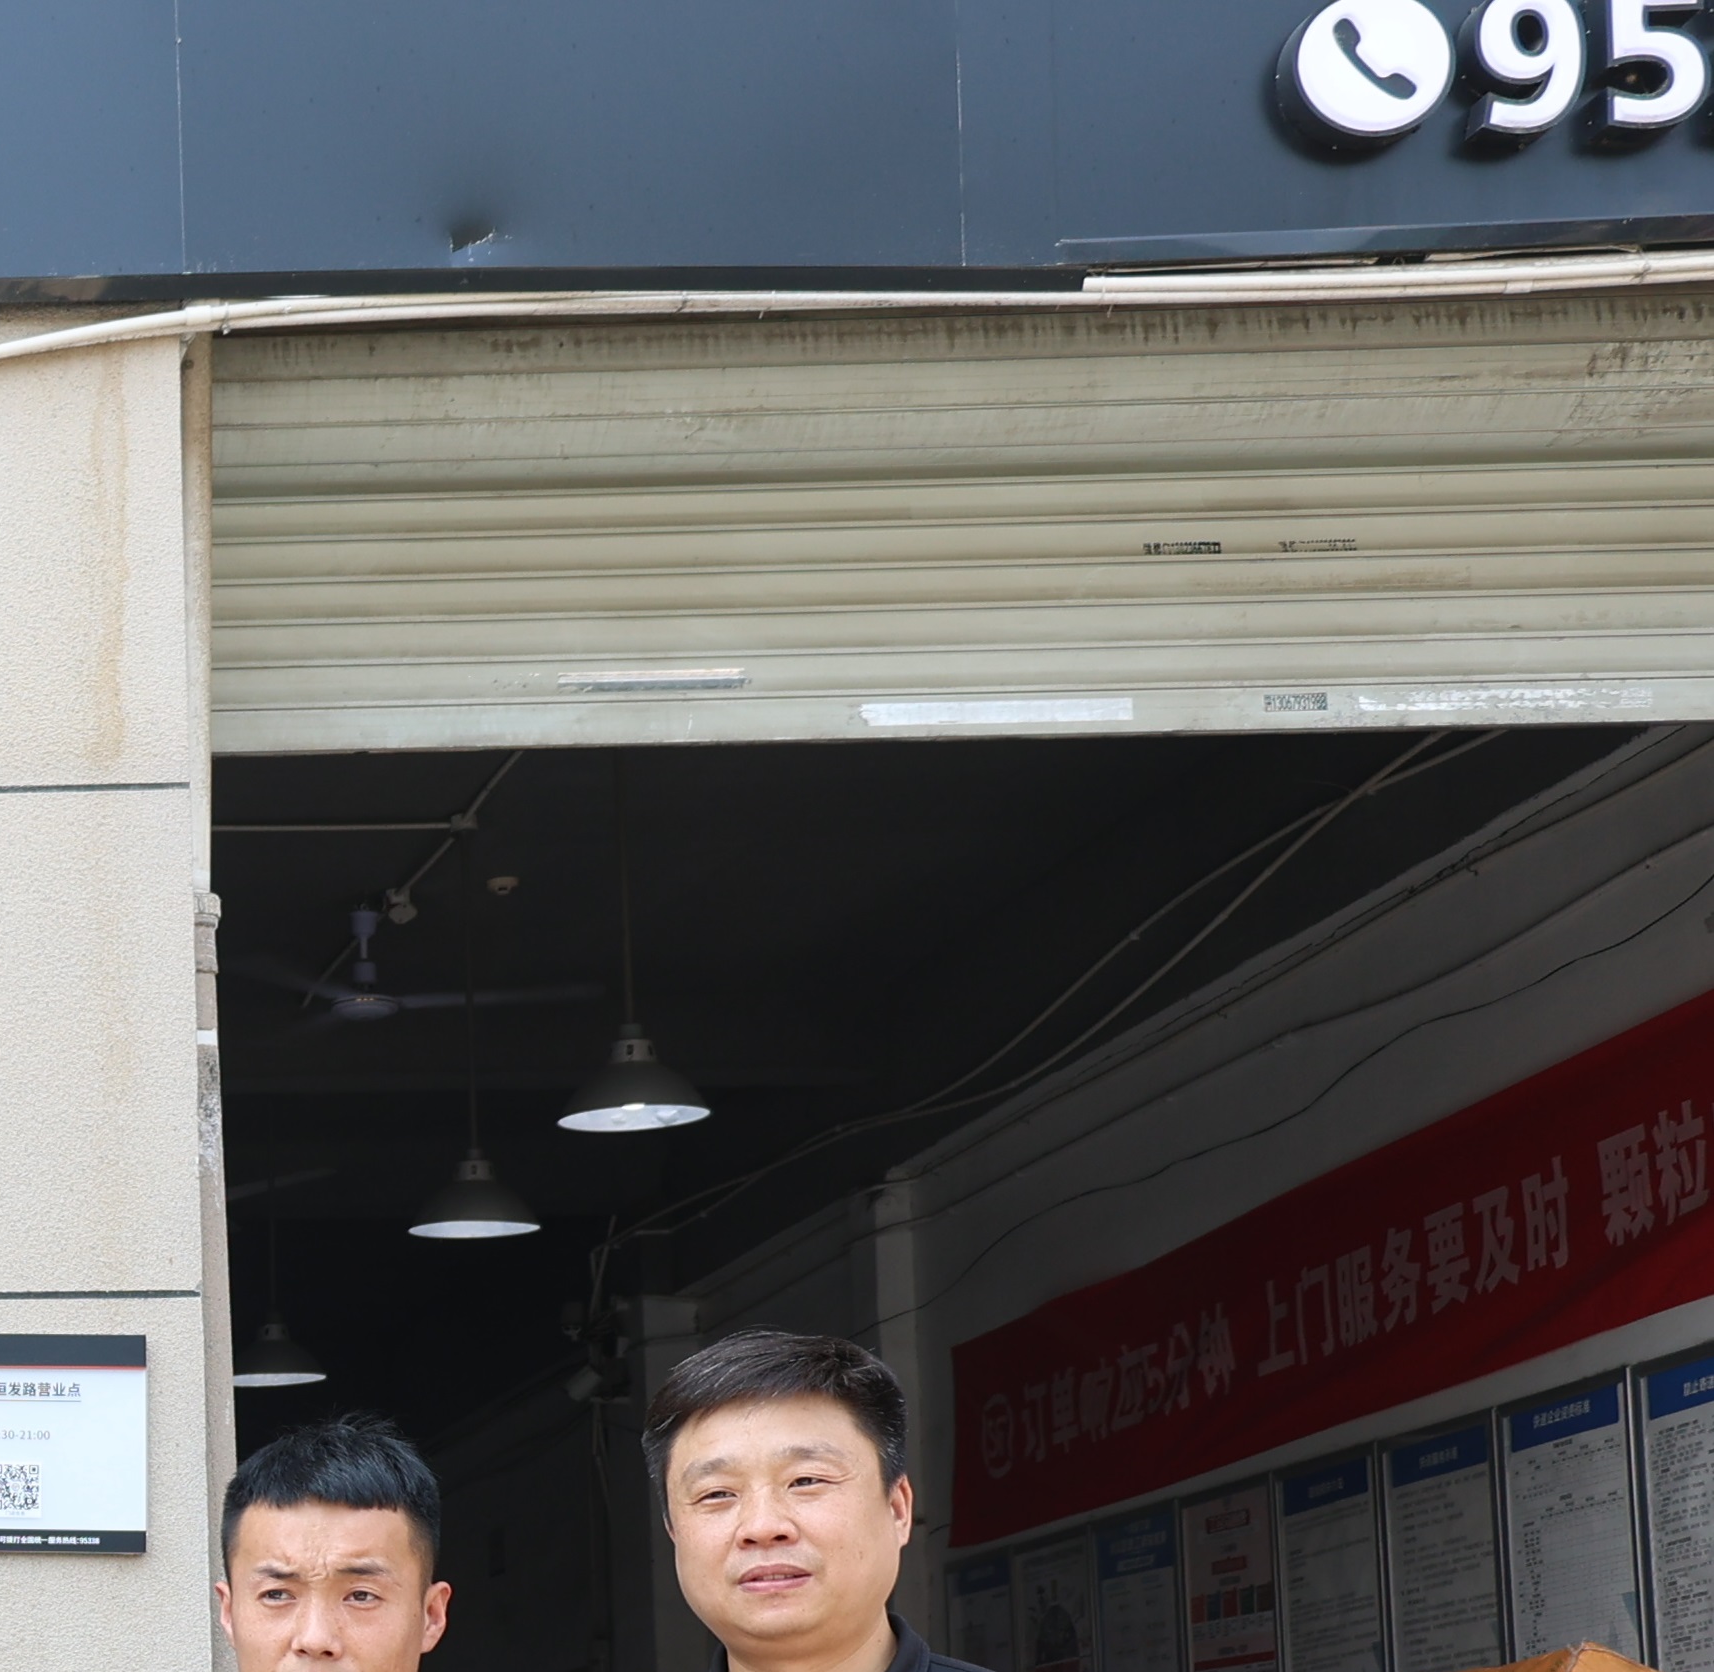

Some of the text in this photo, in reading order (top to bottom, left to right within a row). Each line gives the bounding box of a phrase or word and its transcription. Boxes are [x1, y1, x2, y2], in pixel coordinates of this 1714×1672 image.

[1256, 1156, 1571, 1379] 上门服务要及时
